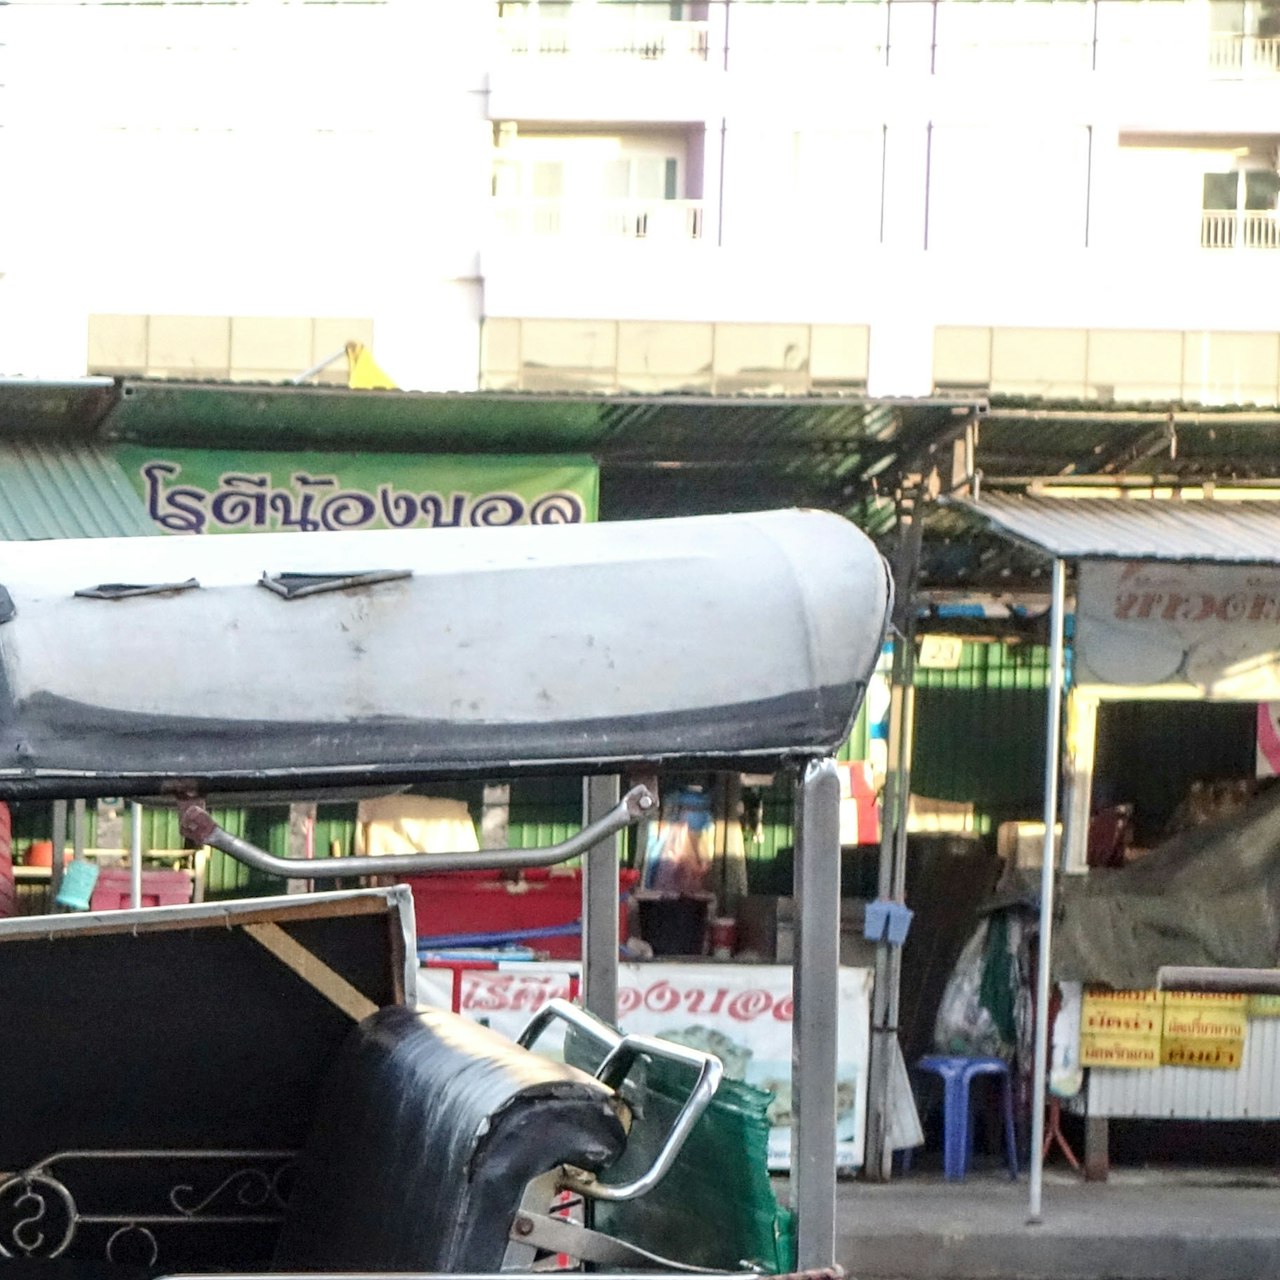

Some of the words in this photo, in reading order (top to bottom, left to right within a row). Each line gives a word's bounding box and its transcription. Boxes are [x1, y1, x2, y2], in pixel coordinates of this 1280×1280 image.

[145, 462, 583, 534] โรตีน้องบอล
